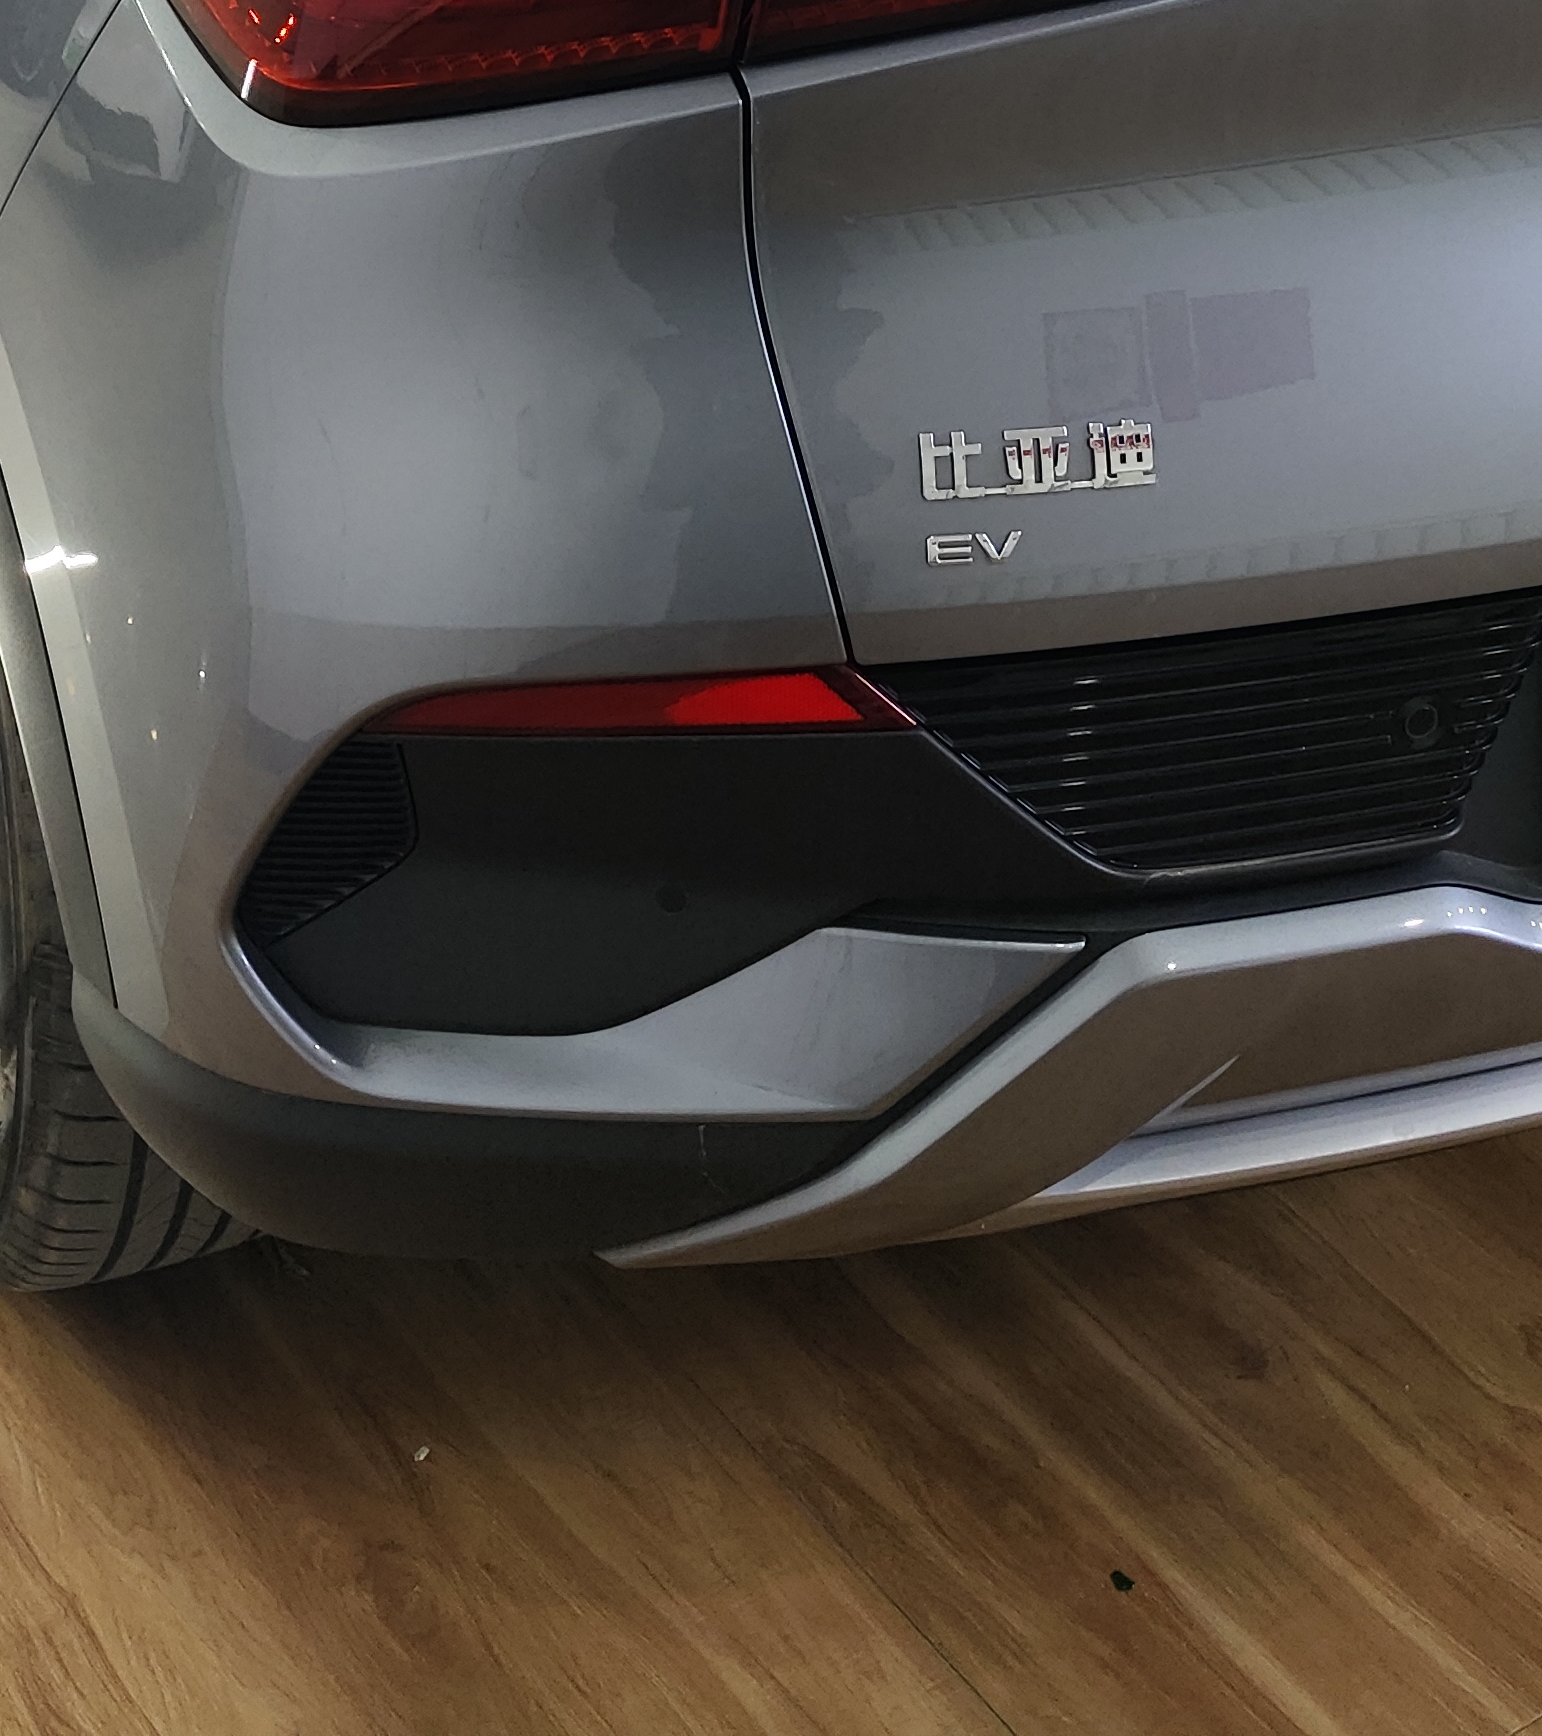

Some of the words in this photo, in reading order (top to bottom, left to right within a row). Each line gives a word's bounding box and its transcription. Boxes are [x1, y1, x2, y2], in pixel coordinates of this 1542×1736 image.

[918, 418, 1157, 501] 比亚迪
[925, 530, 1023, 566] EV
